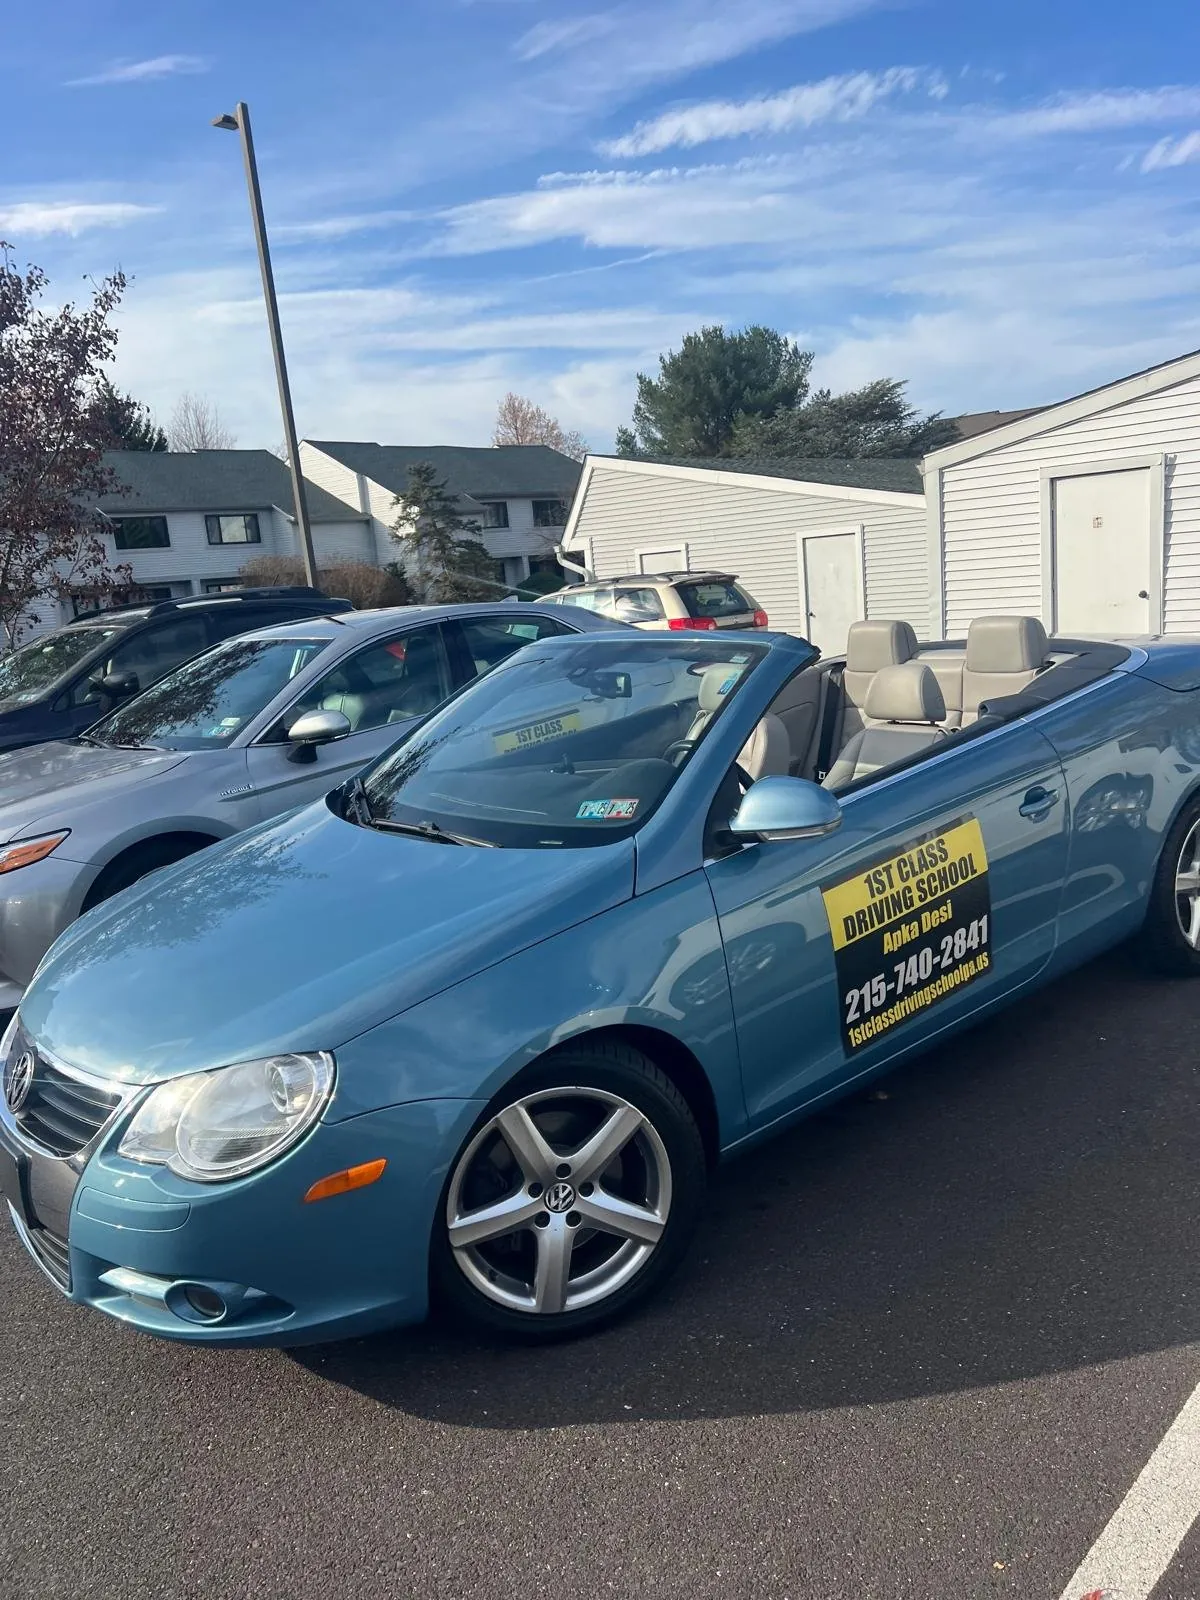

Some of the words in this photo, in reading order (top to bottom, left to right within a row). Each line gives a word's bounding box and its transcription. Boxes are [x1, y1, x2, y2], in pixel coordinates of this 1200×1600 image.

[515, 728, 532, 743] 1ST
[533, 719, 563, 738] CLASS
[843, 886, 914, 941] DRIVING
[916, 853, 977, 902] SCHOOL
[864, 864, 895, 898] 1ST
[897, 838, 949, 883] CLASS
[883, 921, 919, 955] Apka
[921, 900, 953, 933] Desi
[846, 915, 988, 1024] 215-740-2841
[848, 952, 989, 1047] 1stclassdrivingschoolpa.us
